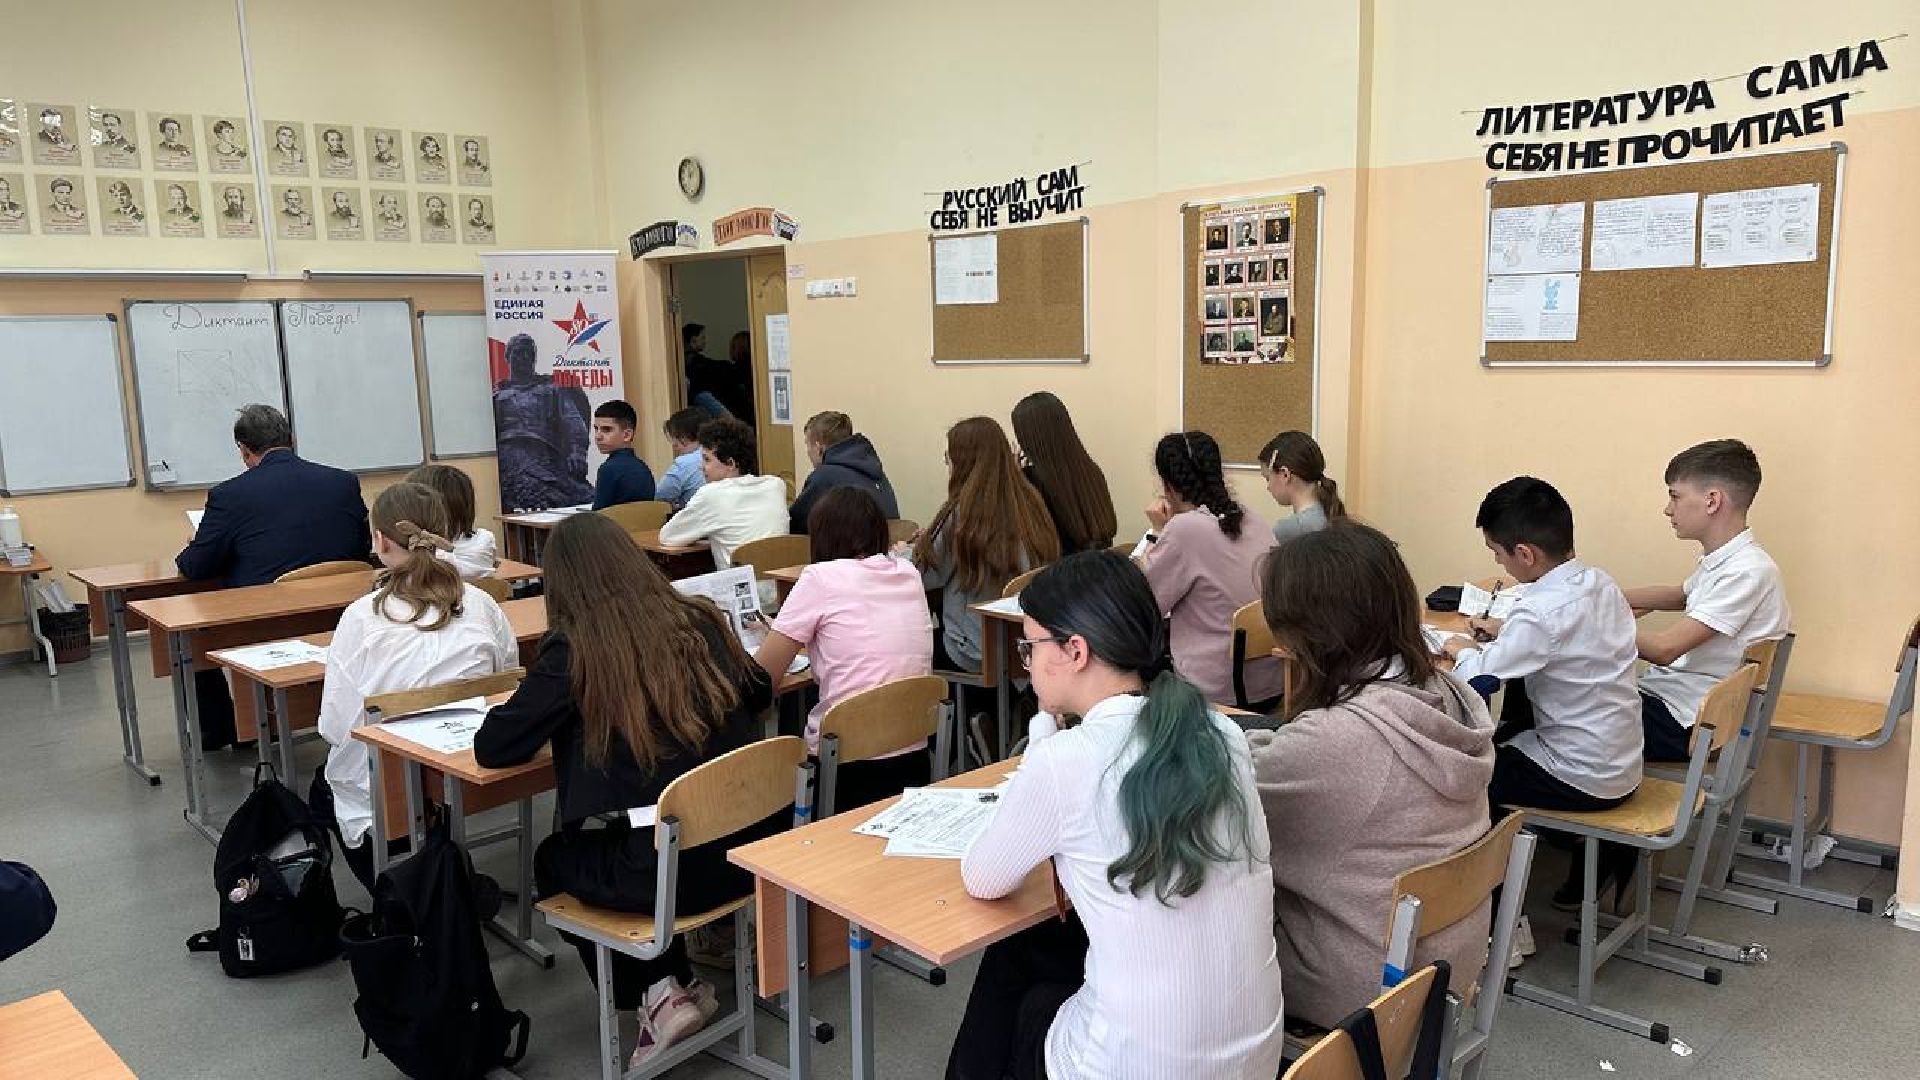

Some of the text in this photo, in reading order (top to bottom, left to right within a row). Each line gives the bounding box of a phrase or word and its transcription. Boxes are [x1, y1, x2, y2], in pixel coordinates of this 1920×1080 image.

[1476, 40, 1888, 136] ЛИТЕРАТУРА САМА
[1485, 92, 1850, 172] СЕБЯ НЕ ПРОЧИТАЕТ
[942, 165, 1078, 210] РУССКИЙ САМ
[930, 186, 1085, 230] СЕБЯ НЕ ВЫУЧИТ
[163, 303, 269, 330] Диктант
[494, 299, 544, 310] ЕДИНАЯ
[494, 311, 544, 320] РОССИЯ
[552, 354, 610, 367] Диктант
[552, 368, 613, 389] ПОБЕДЫ
